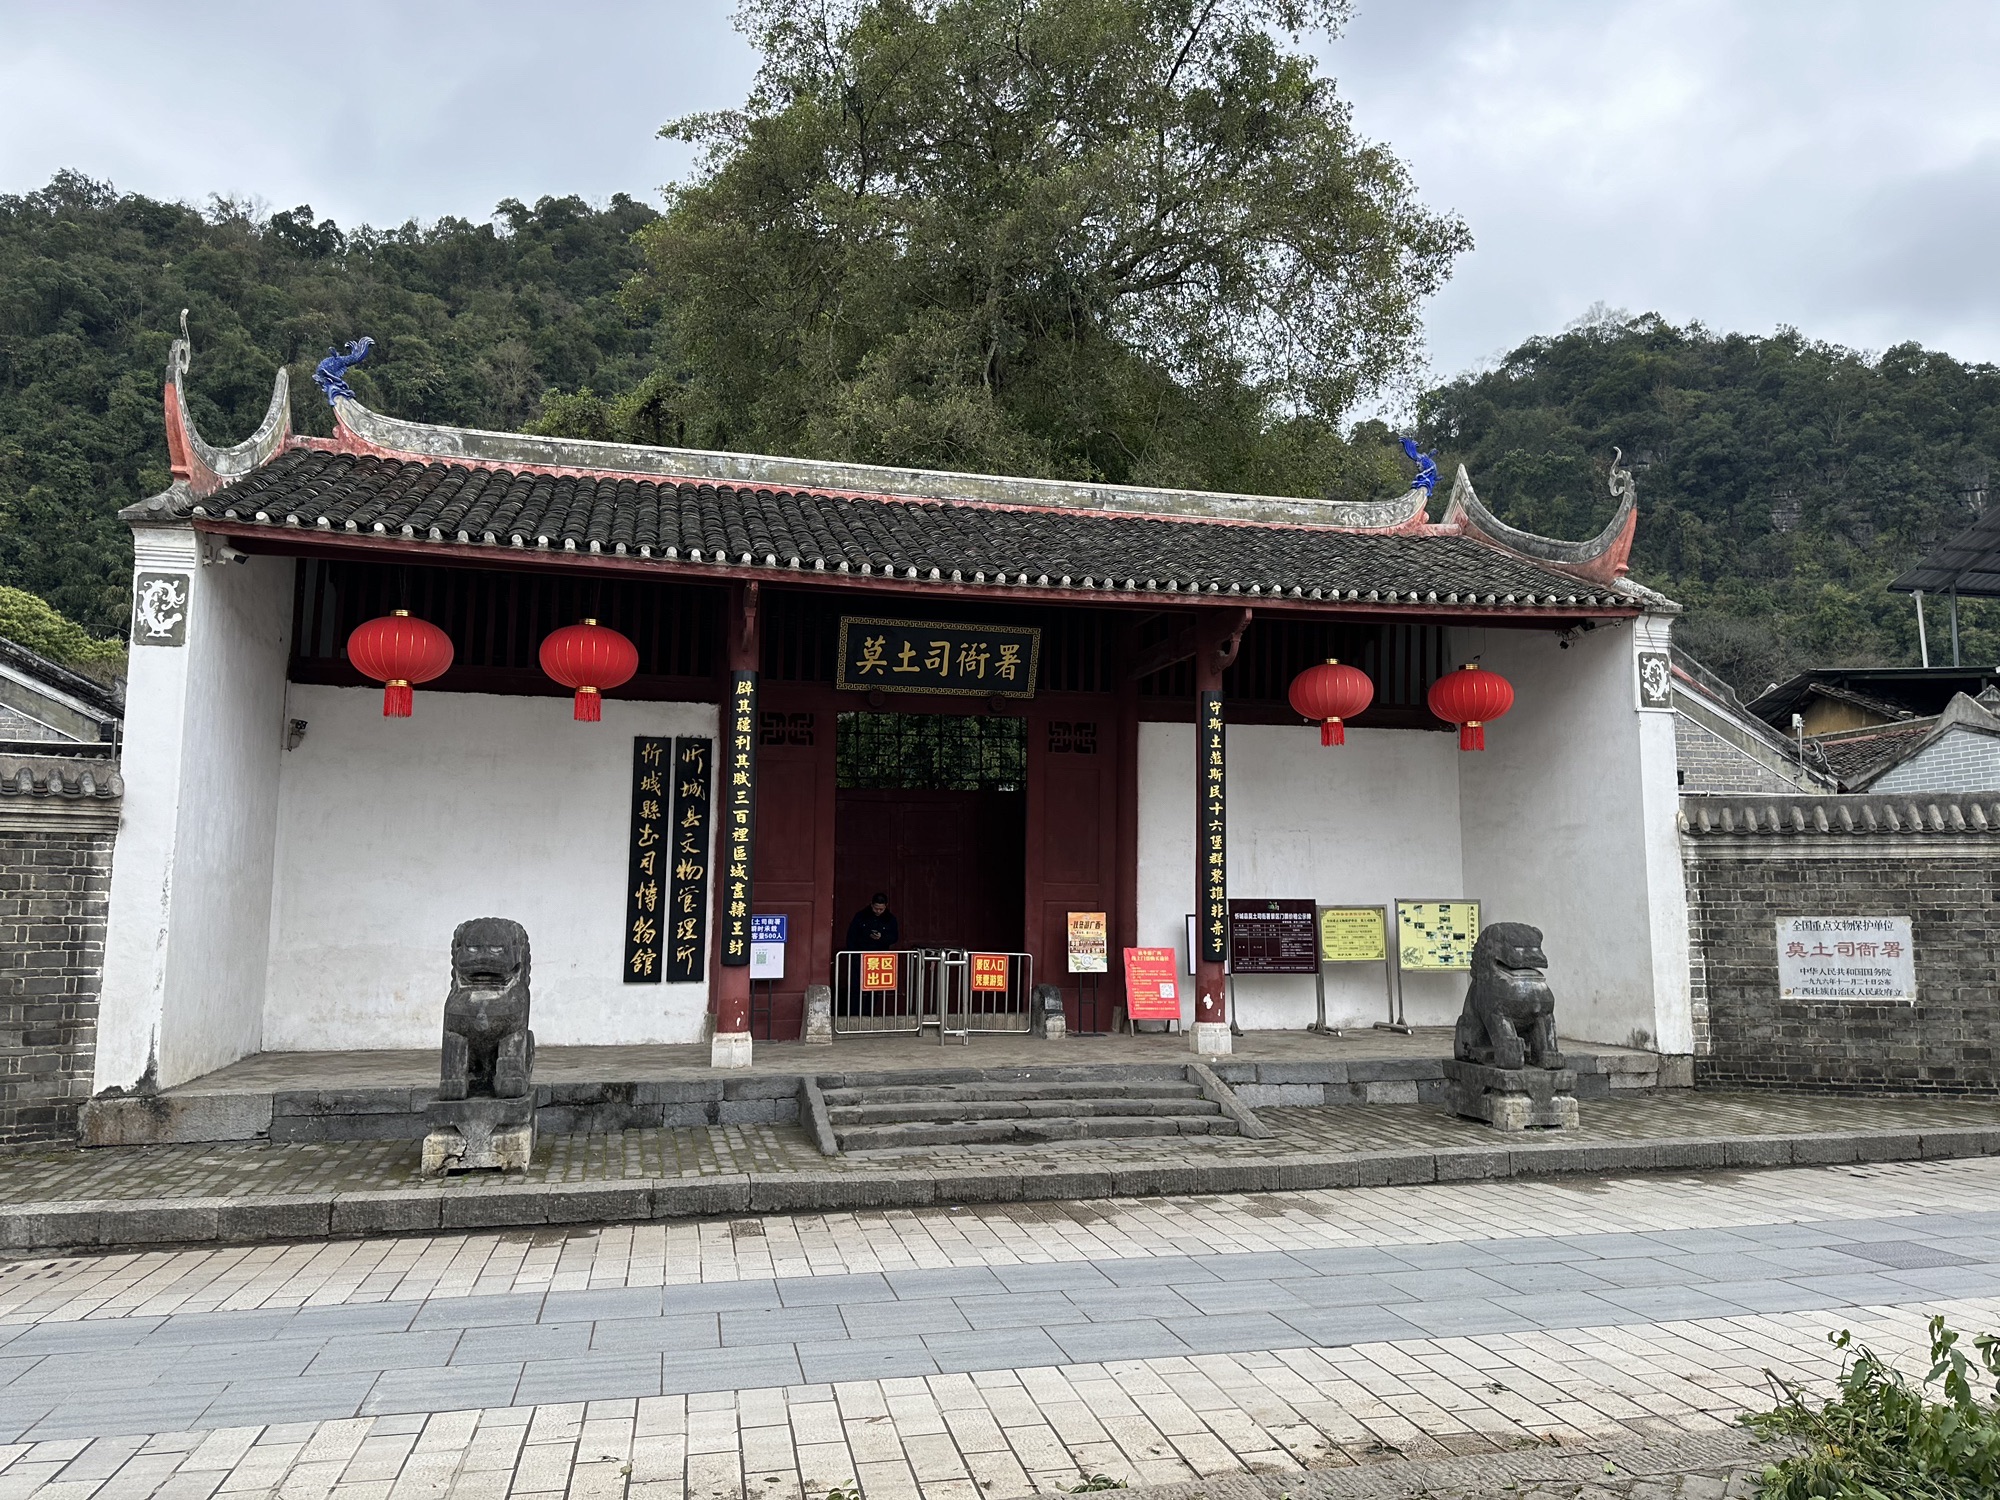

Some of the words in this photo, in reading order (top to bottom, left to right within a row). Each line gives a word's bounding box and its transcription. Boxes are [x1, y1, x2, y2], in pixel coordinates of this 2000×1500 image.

[856, 635, 1022, 681] 莫土司衙署
[675, 744, 706, 976] 忻城县文物管理所
[1792, 920, 1894, 932] 全国重点文物保护单位
[1785, 941, 1904, 958] 莫土司衙署
[867, 957, 893, 971] 景区
[975, 959, 1004, 971] 景区入口
[867, 972, 893, 985] 出口
[1799, 968, 1893, 976] 中华人民共和国国务院
[975, 974, 1004, 987] 凭票游览
[1802, 978, 1892, 986] 一九九六年十一月二十日公布
[1792, 987, 1903, 997] 广西壮族自治区人民政府立
